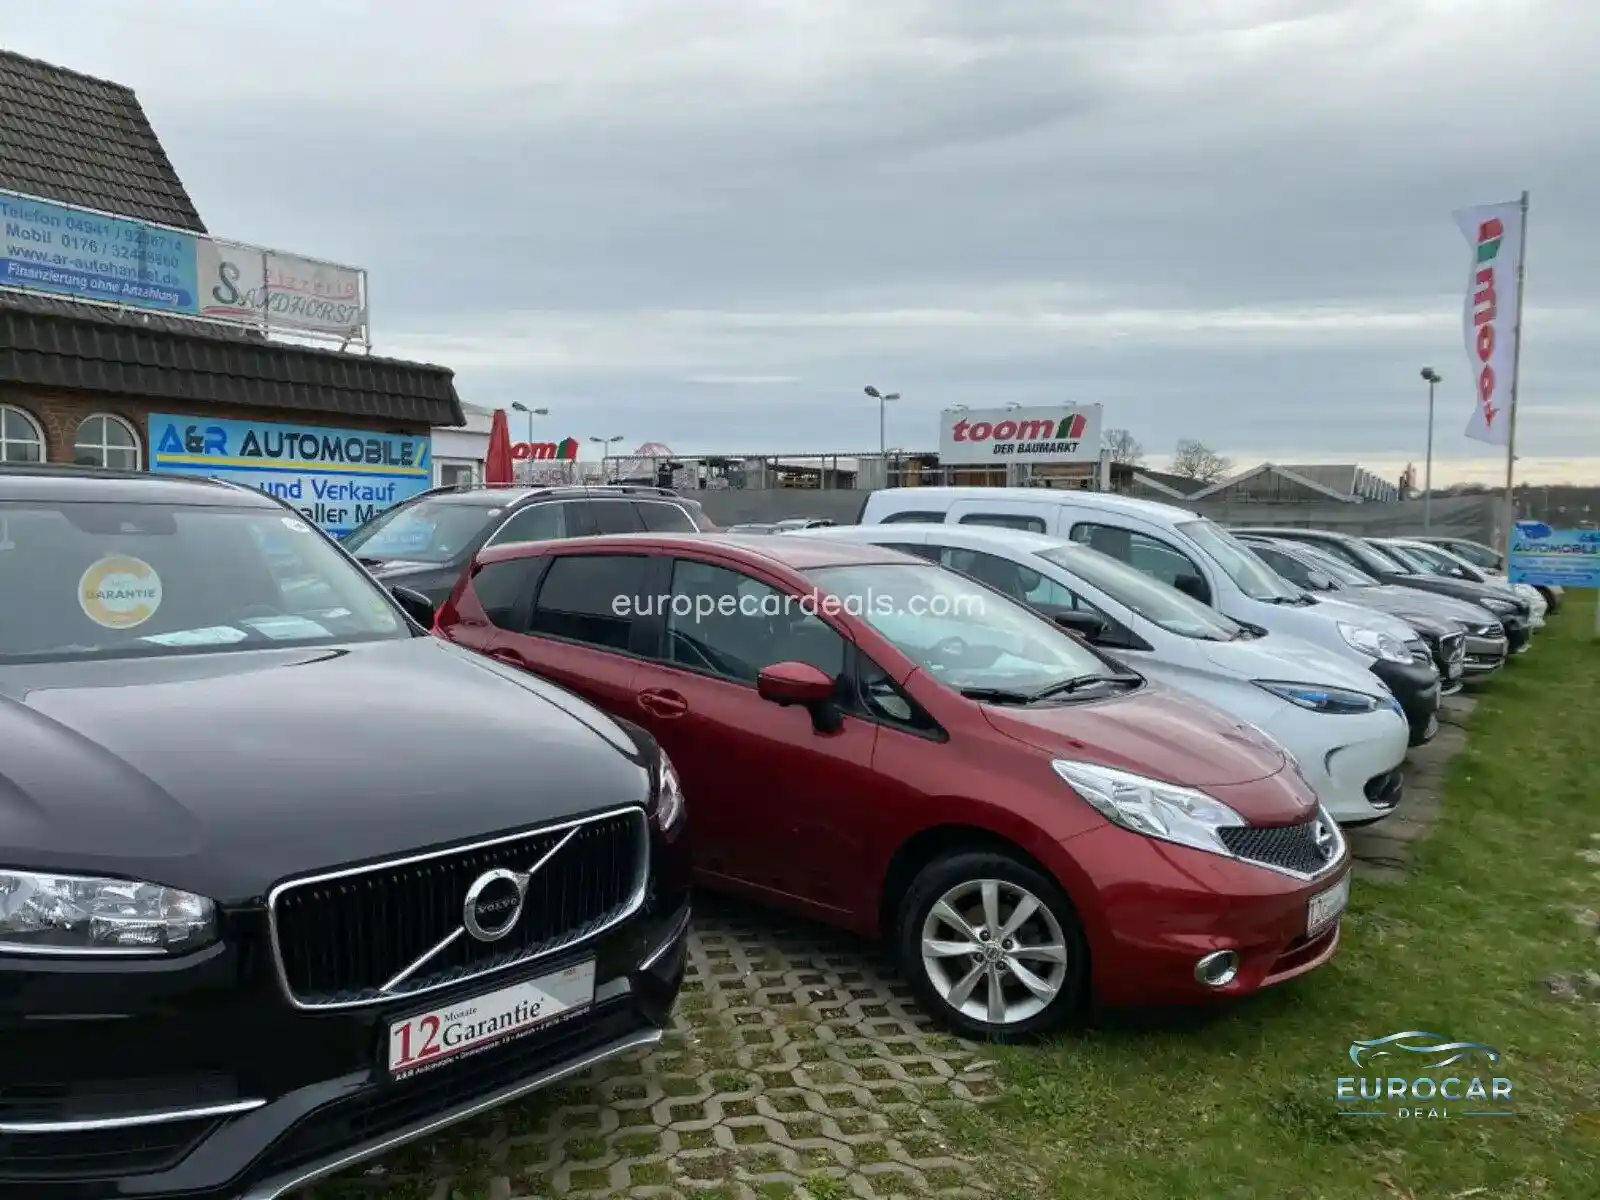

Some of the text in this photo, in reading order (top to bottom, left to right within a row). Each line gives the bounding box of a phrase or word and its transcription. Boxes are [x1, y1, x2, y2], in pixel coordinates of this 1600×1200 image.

[2, 203, 60, 227] Telefon
[6, 223, 51, 243] Mobil
[157, 423, 229, 455] A&R
[952, 417, 1056, 442] toom
[993, 442, 1080, 455] DER BAUMARKT
[311, 479, 396, 501] Verkauf
[394, 1015, 440, 1065] 12
[443, 1007, 478, 1021] Monate
